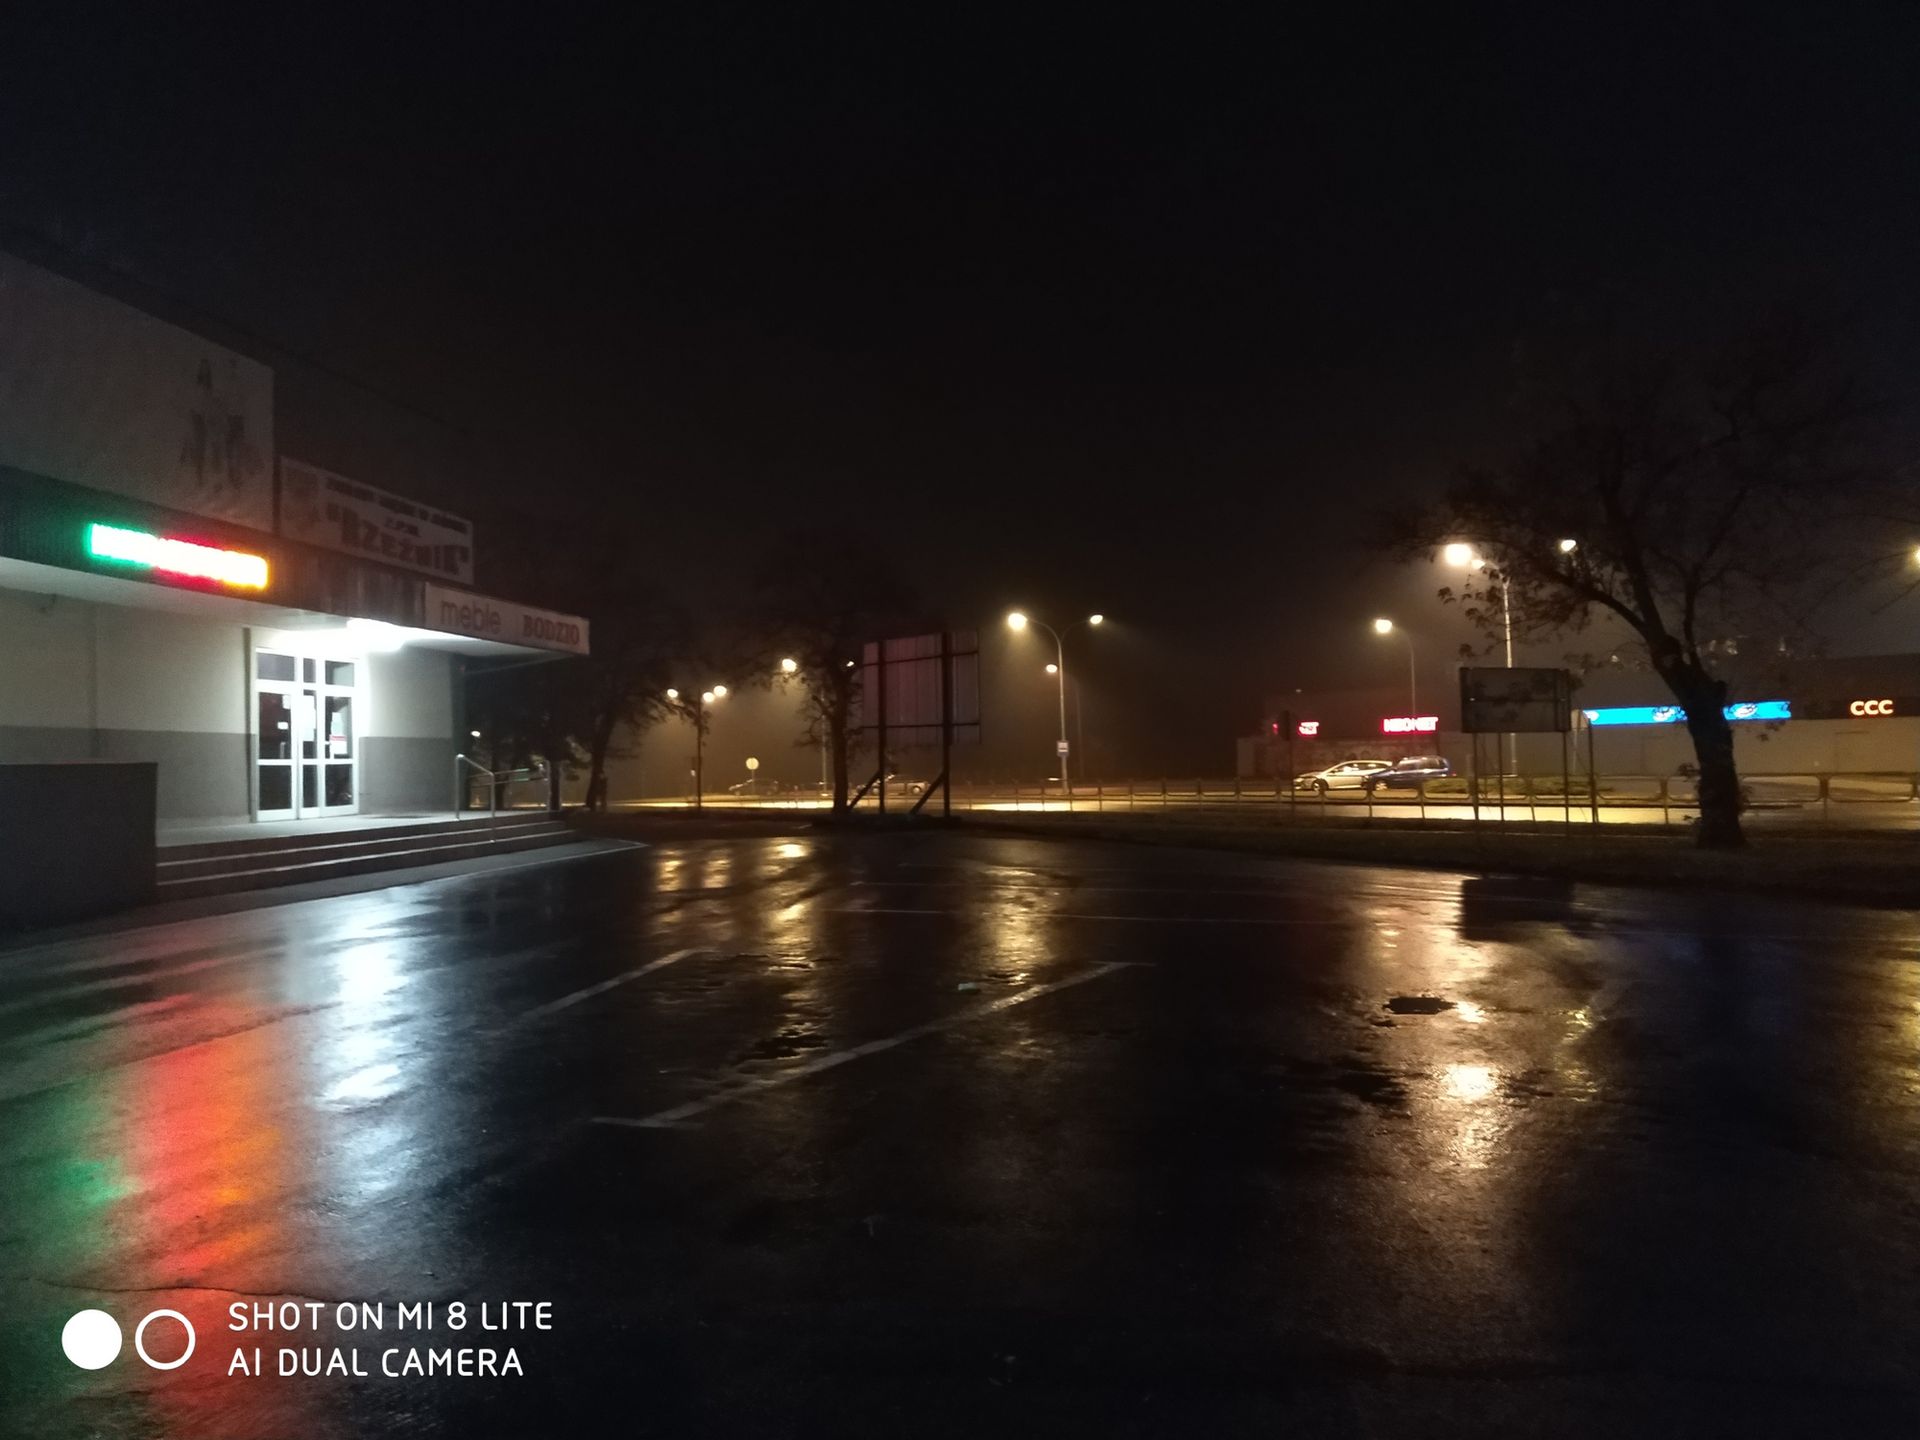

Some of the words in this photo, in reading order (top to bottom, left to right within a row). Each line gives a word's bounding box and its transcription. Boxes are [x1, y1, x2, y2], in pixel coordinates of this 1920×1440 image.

[440, 600, 502, 634] meble
[522, 614, 580, 645] BODZIO
[1850, 699, 1894, 716] CCC
